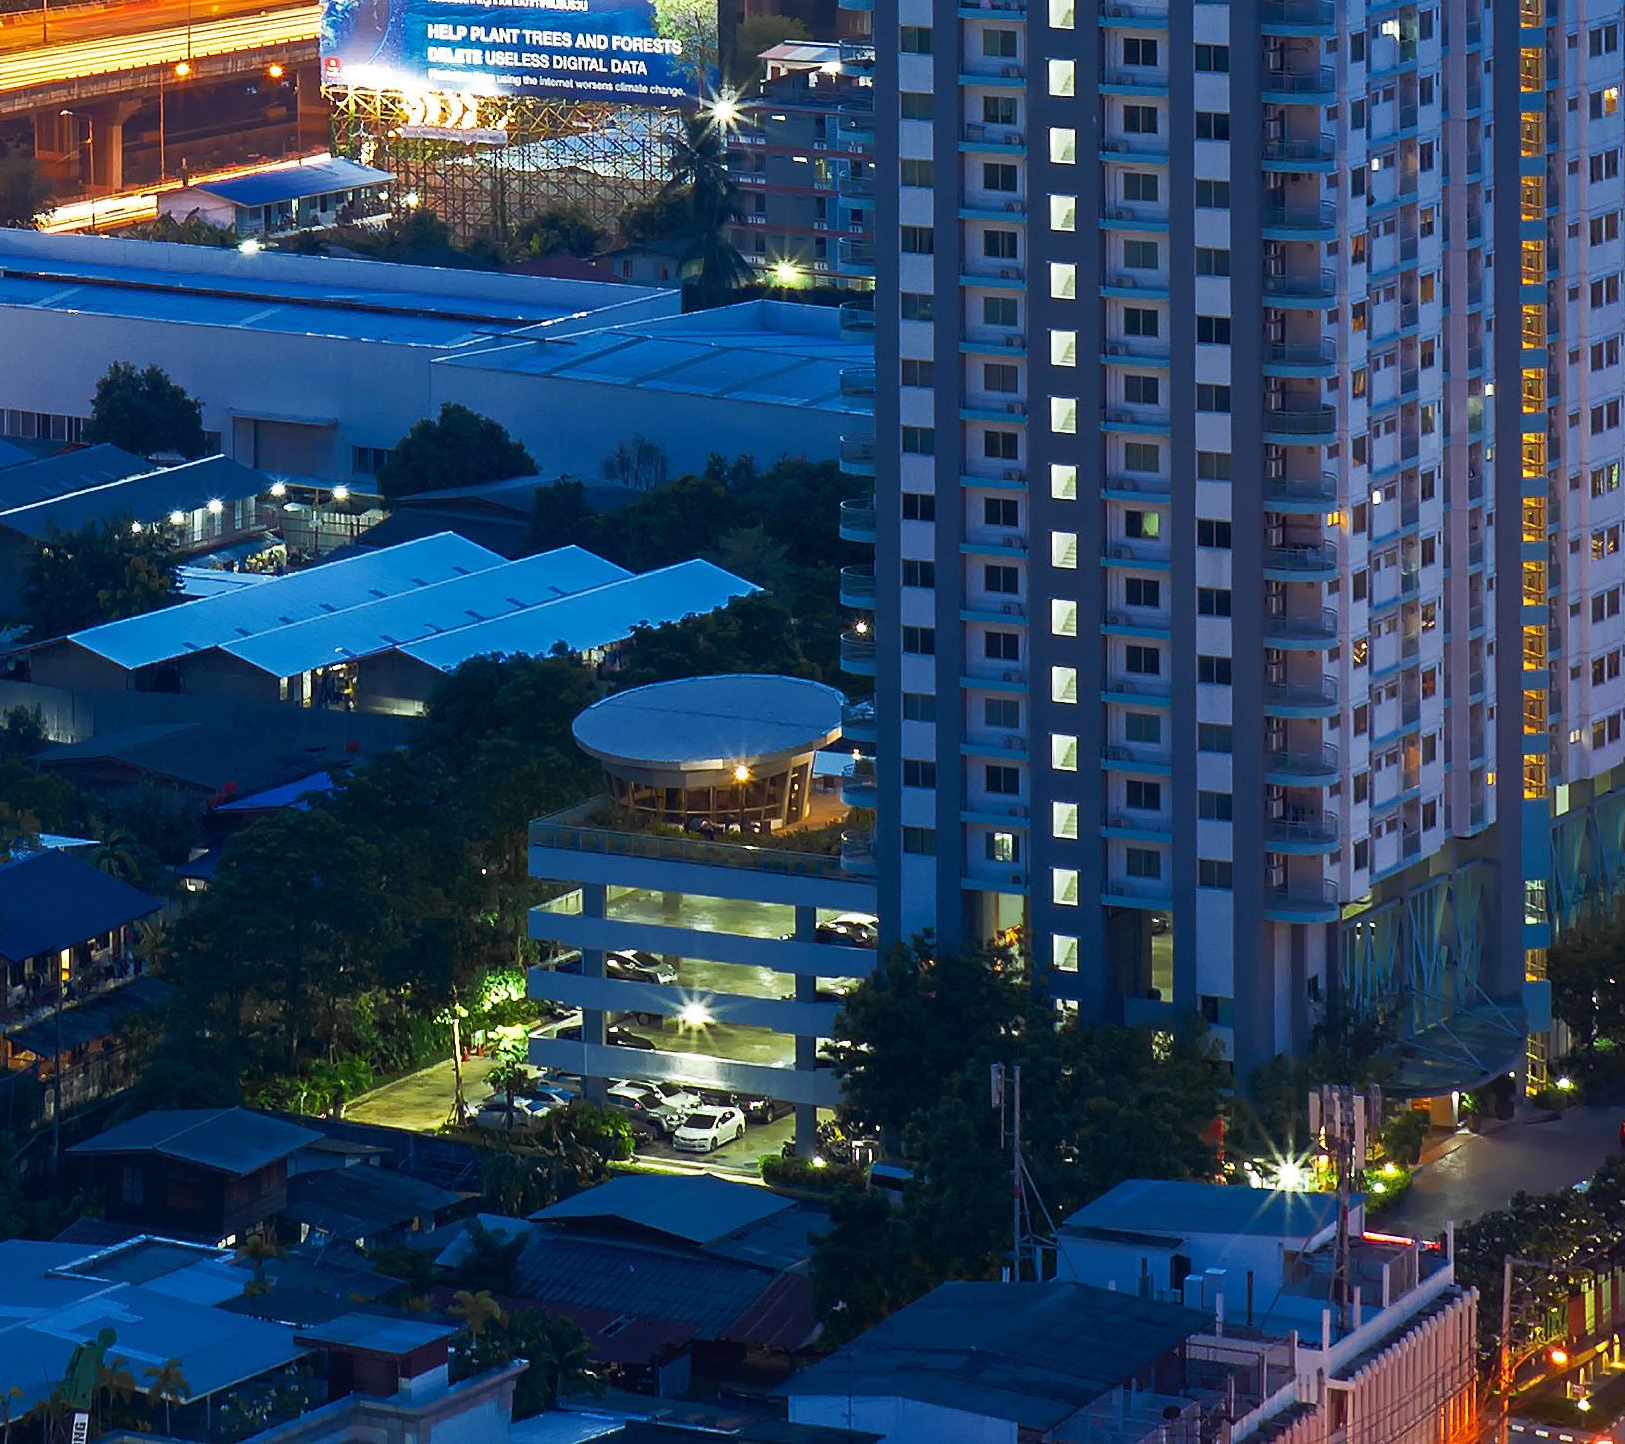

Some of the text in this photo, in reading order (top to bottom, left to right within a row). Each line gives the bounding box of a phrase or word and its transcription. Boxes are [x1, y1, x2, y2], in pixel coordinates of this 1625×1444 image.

[427, 23, 683, 56] HELP PLANT TREES AND FORESTS
[427, 46, 648, 76] DELETE USELESS DIGITAL DATA
[496, 73, 521, 87] using
[522, 74, 538, 86] the
[575, 80, 613, 91] worsens
[615, 81, 648, 93] climate
[649, 84, 687, 97] change.
